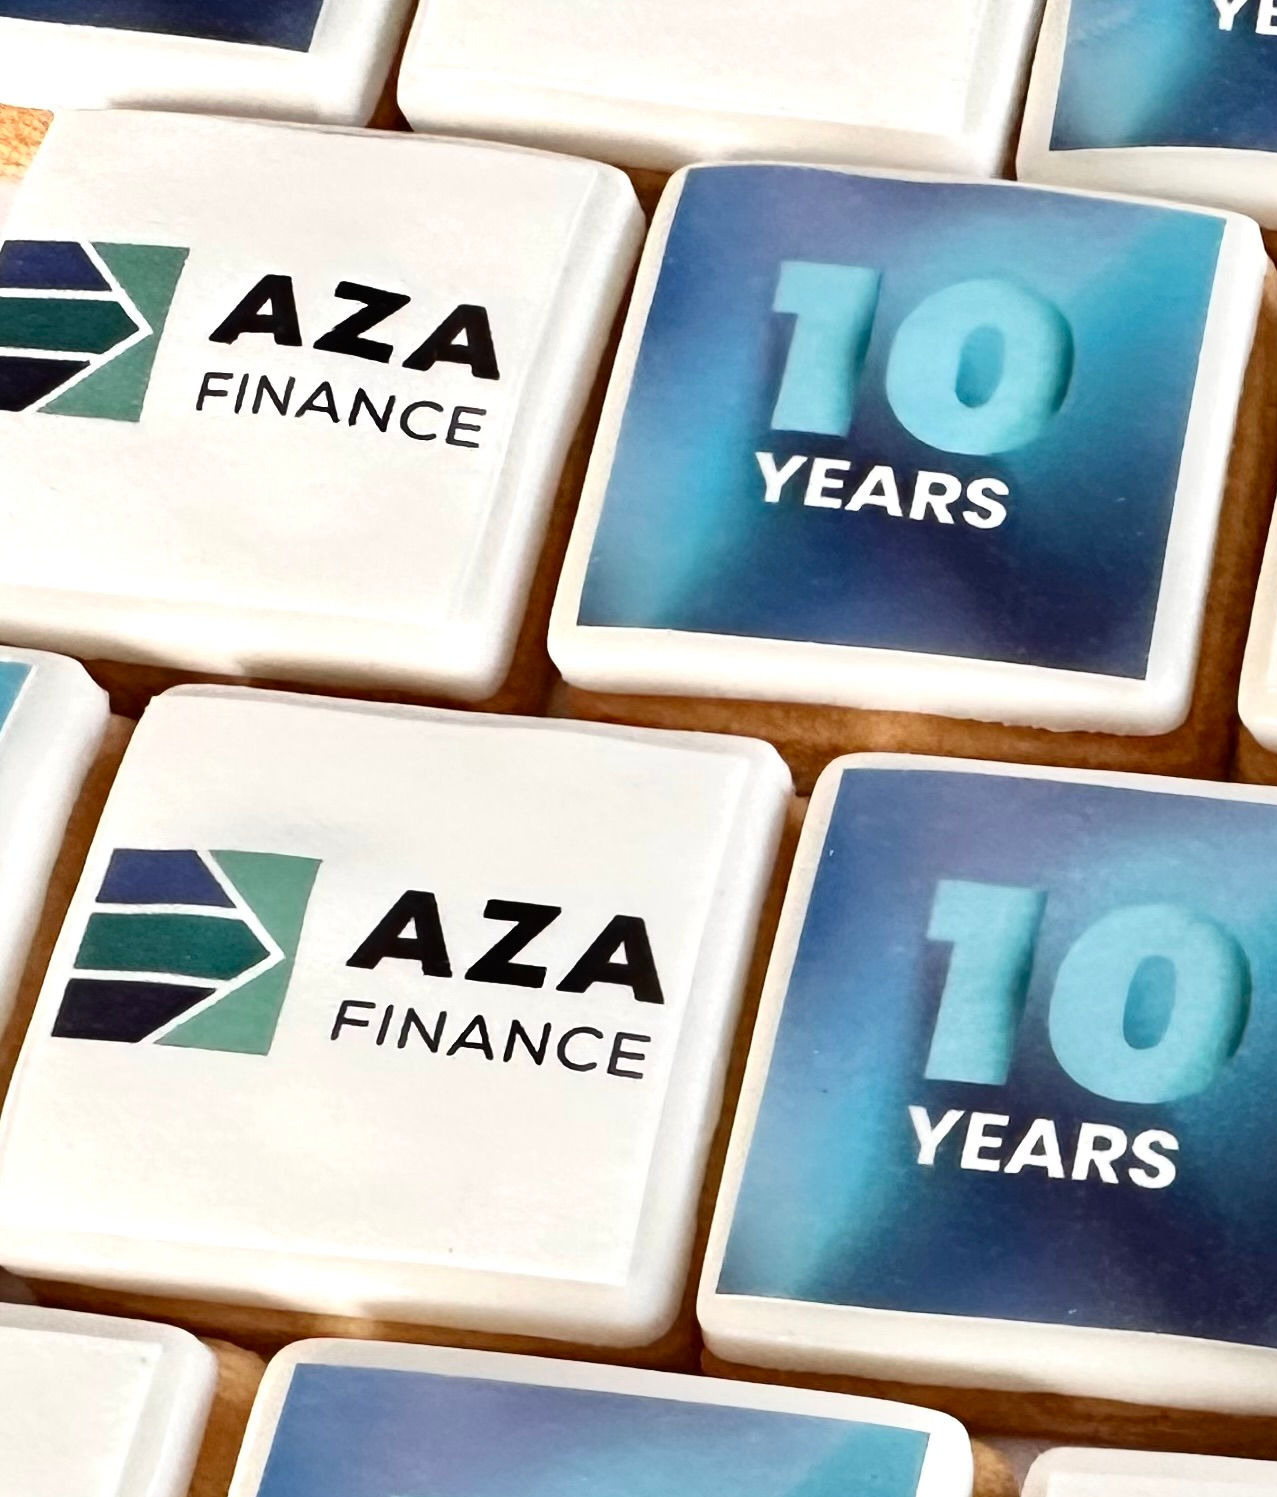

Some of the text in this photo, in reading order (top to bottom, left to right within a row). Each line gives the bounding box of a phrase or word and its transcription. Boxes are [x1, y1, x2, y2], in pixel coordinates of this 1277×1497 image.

[208, 273, 500, 381] AZA
[772, 260, 1074, 456] 10
[195, 371, 487, 449] FINANCE
[755, 451, 1009, 529] YEARS
[345, 889, 665, 1005] AZA
[927, 880, 1250, 1104] 10
[330, 999, 651, 1080] FINANCE
[909, 1105, 1179, 1189] YEARS
